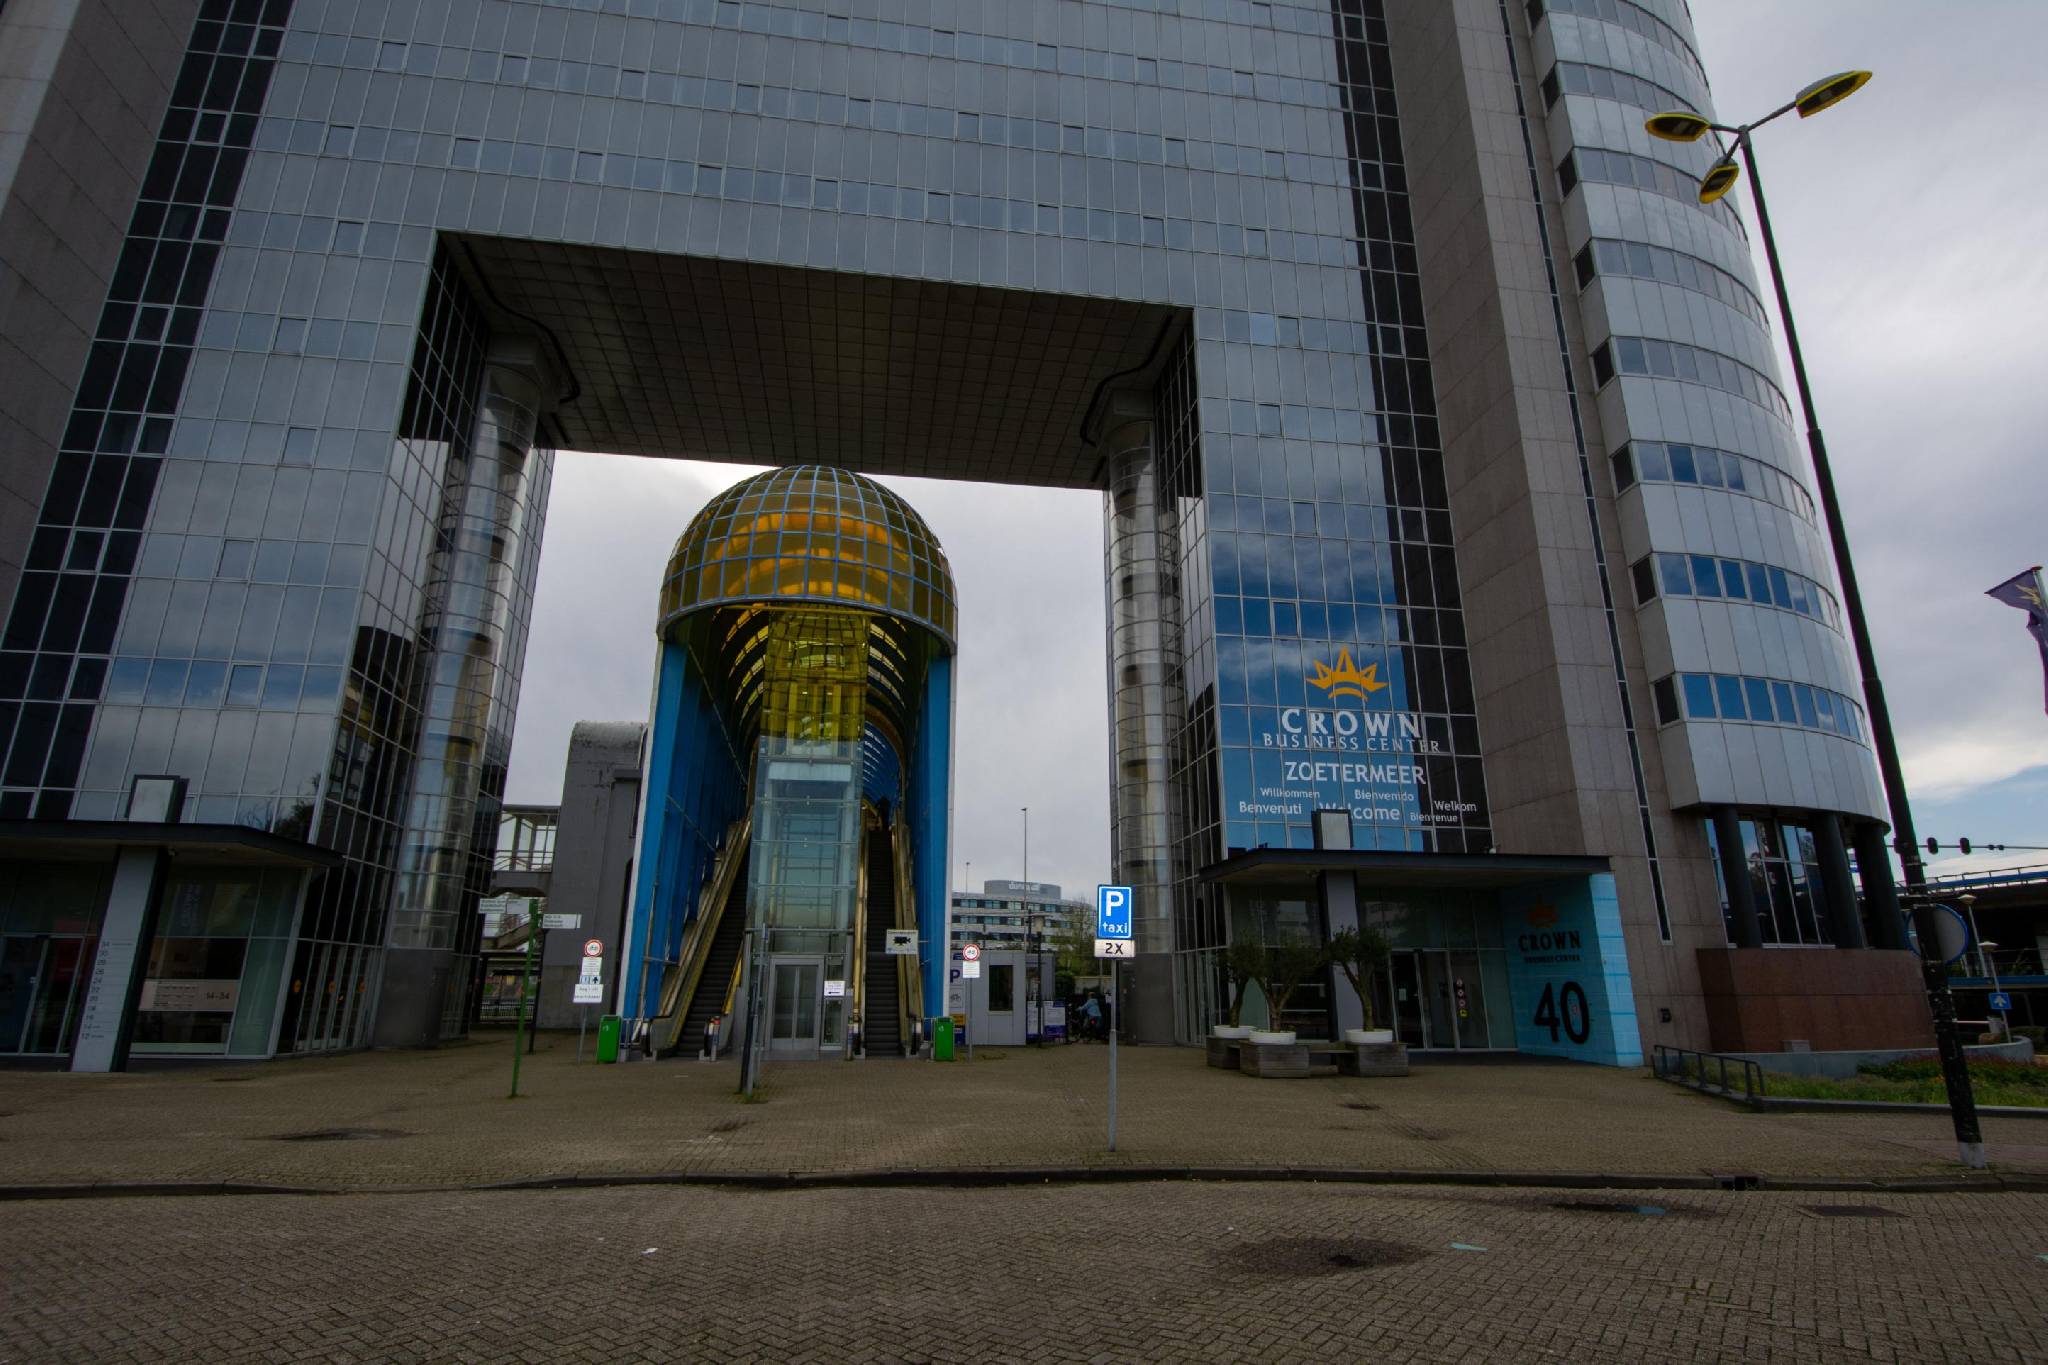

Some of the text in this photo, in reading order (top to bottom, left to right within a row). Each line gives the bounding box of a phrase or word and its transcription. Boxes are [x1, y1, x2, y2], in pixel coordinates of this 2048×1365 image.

[1281, 708, 1422, 738] CROWN
[1263, 732, 1441, 754] BUSINESS CENTER
[1284, 761, 1427, 785] ZOETERMEER
[1260, 786, 1321, 799] Willkommen
[1354, 788, 1415, 801] Bienvenido
[1239, 800, 1302, 815] Benvenuti
[1319, 802, 1400, 820] come
[1433, 799, 1478, 813] Welkom
[1409, 811, 1458, 823] Bienvenue
[1105, 890, 1124, 917] P
[1102, 921, 1128, 934] taxi
[1105, 942, 1124, 955] 2X
[1519, 931, 1581, 951] CROWN
[1535, 981, 1589, 1044] 40
